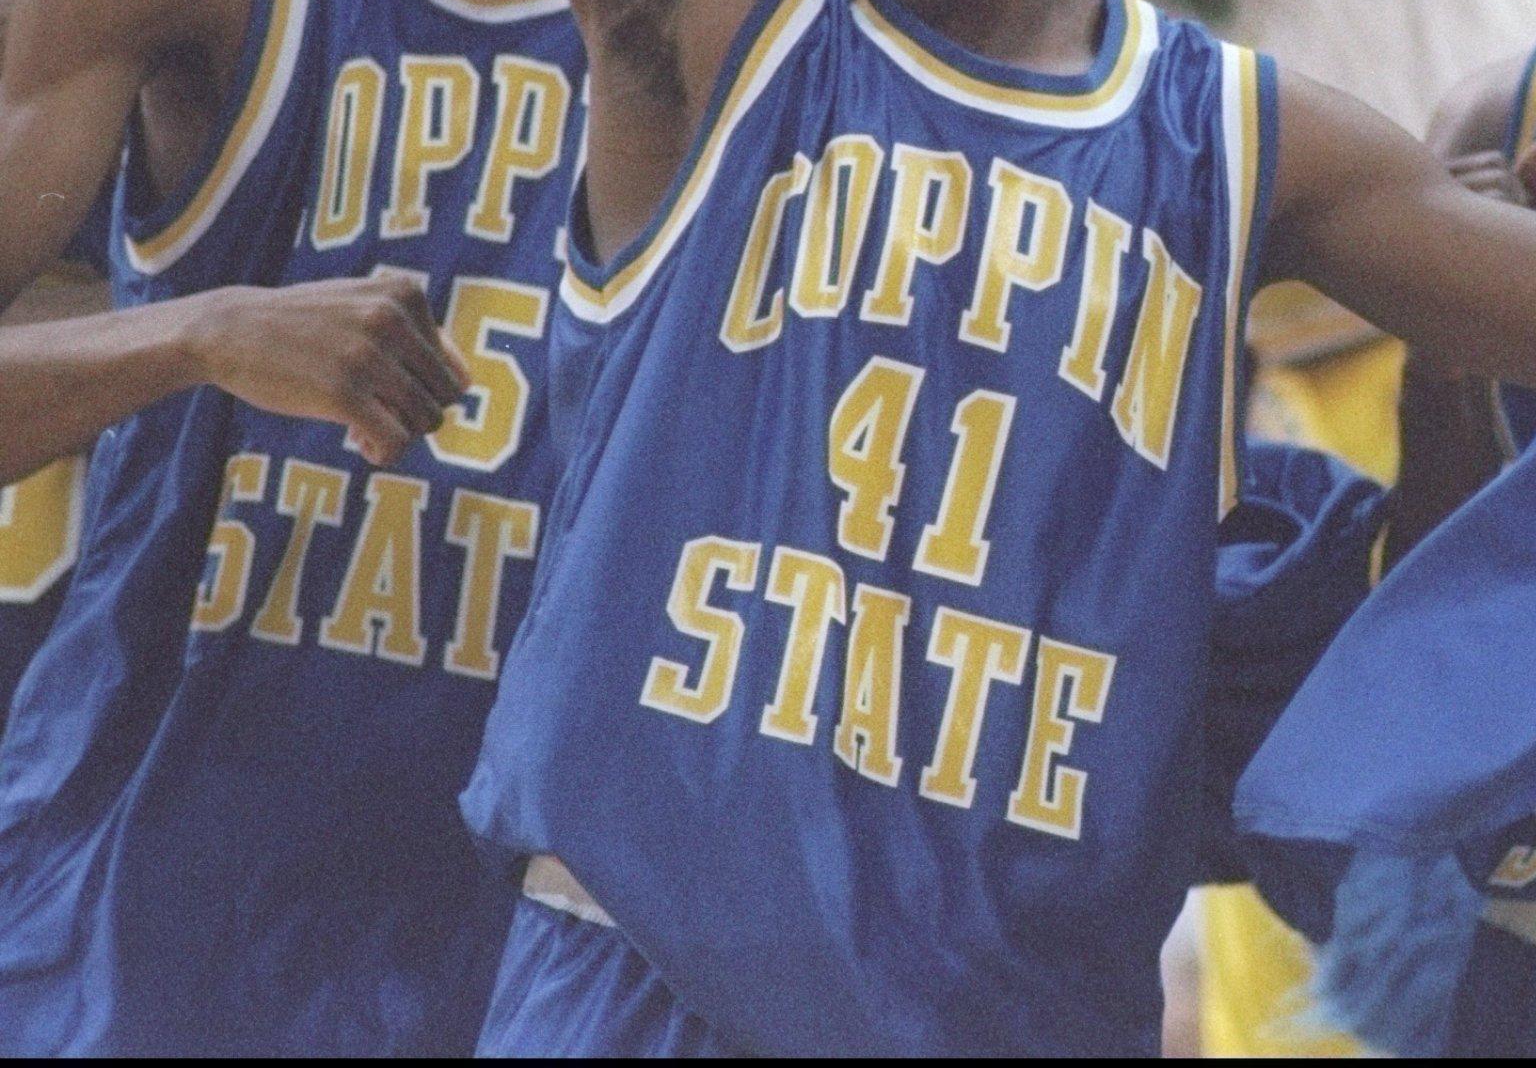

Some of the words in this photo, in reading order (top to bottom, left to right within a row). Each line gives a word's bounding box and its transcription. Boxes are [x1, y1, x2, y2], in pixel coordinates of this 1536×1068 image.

[719, 134, 1203, 471] COPPIN
[828, 354, 1017, 586] 41
[639, 534, 1117, 841] STATE
